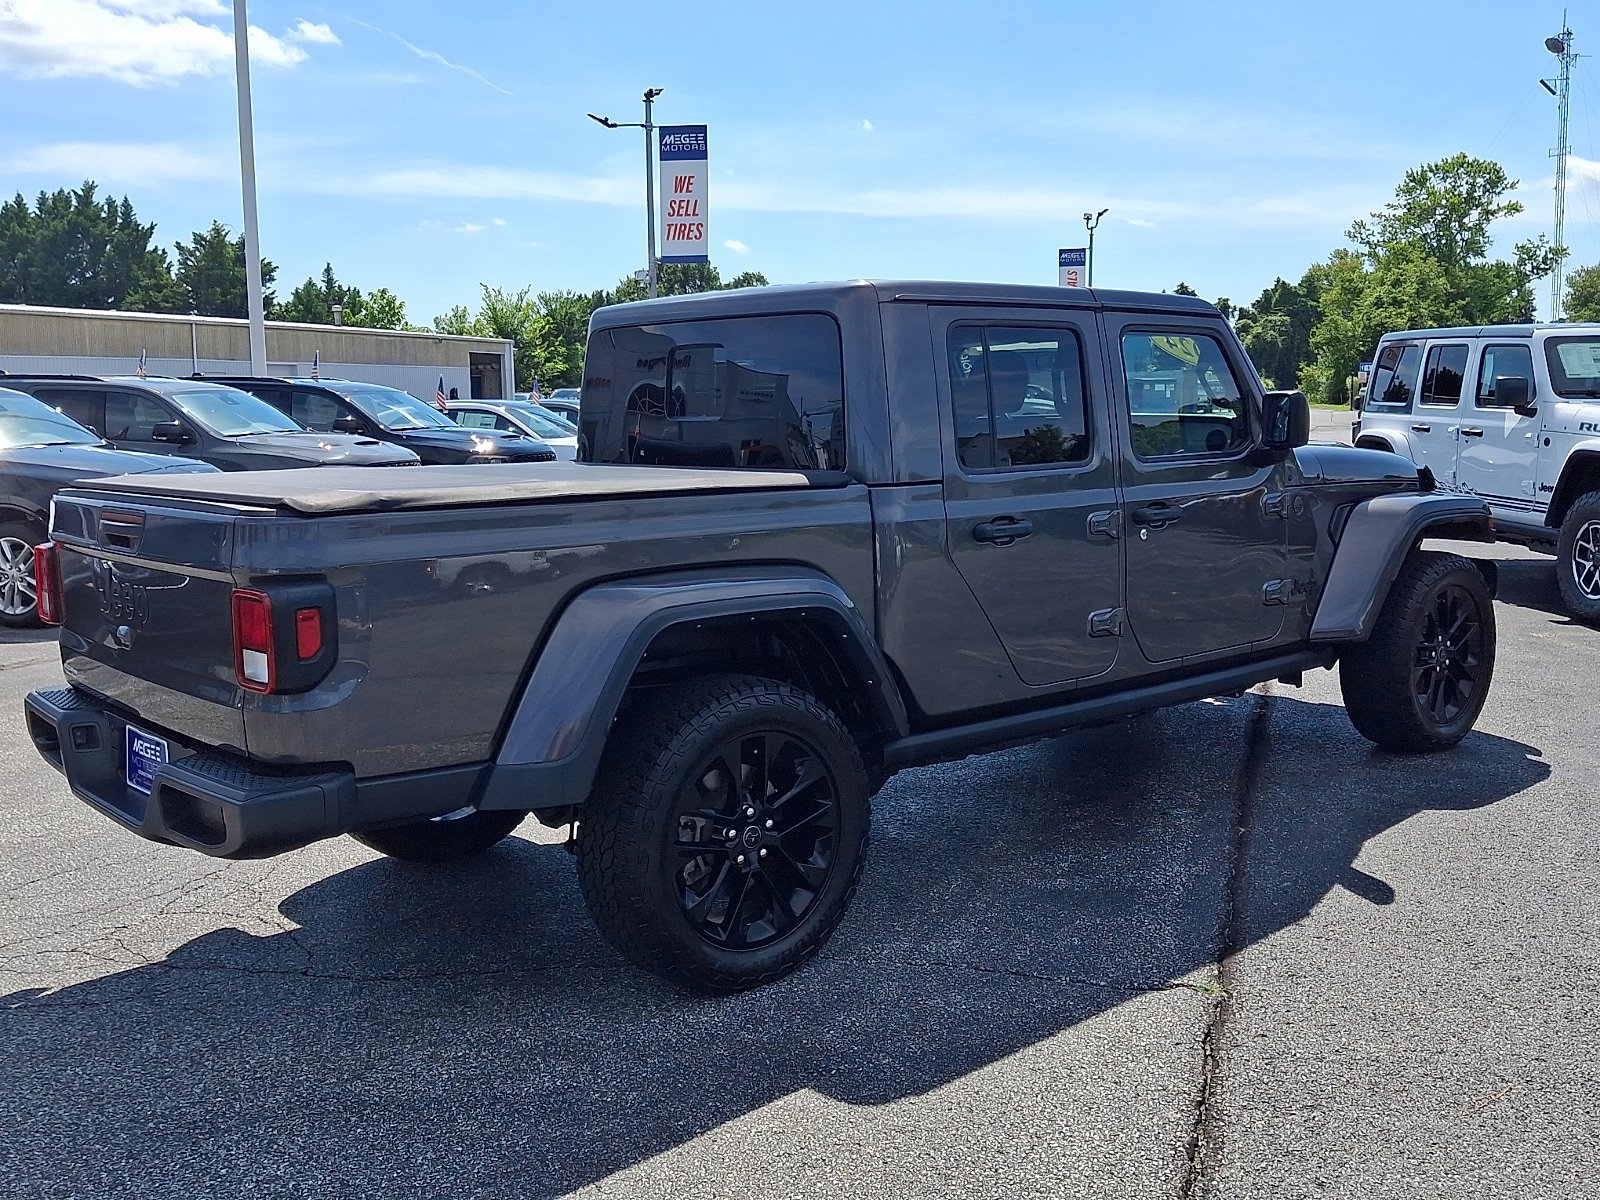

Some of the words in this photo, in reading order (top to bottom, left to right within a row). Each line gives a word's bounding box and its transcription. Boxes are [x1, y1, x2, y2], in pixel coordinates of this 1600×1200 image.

[661, 134, 705, 144] MEGEE
[661, 144, 706, 152] MOTORS
[674, 175, 695, 193] WE
[668, 199, 699, 217] SELL
[666, 223, 703, 240] TIRES
[133, 737, 162, 763] MEGEE
